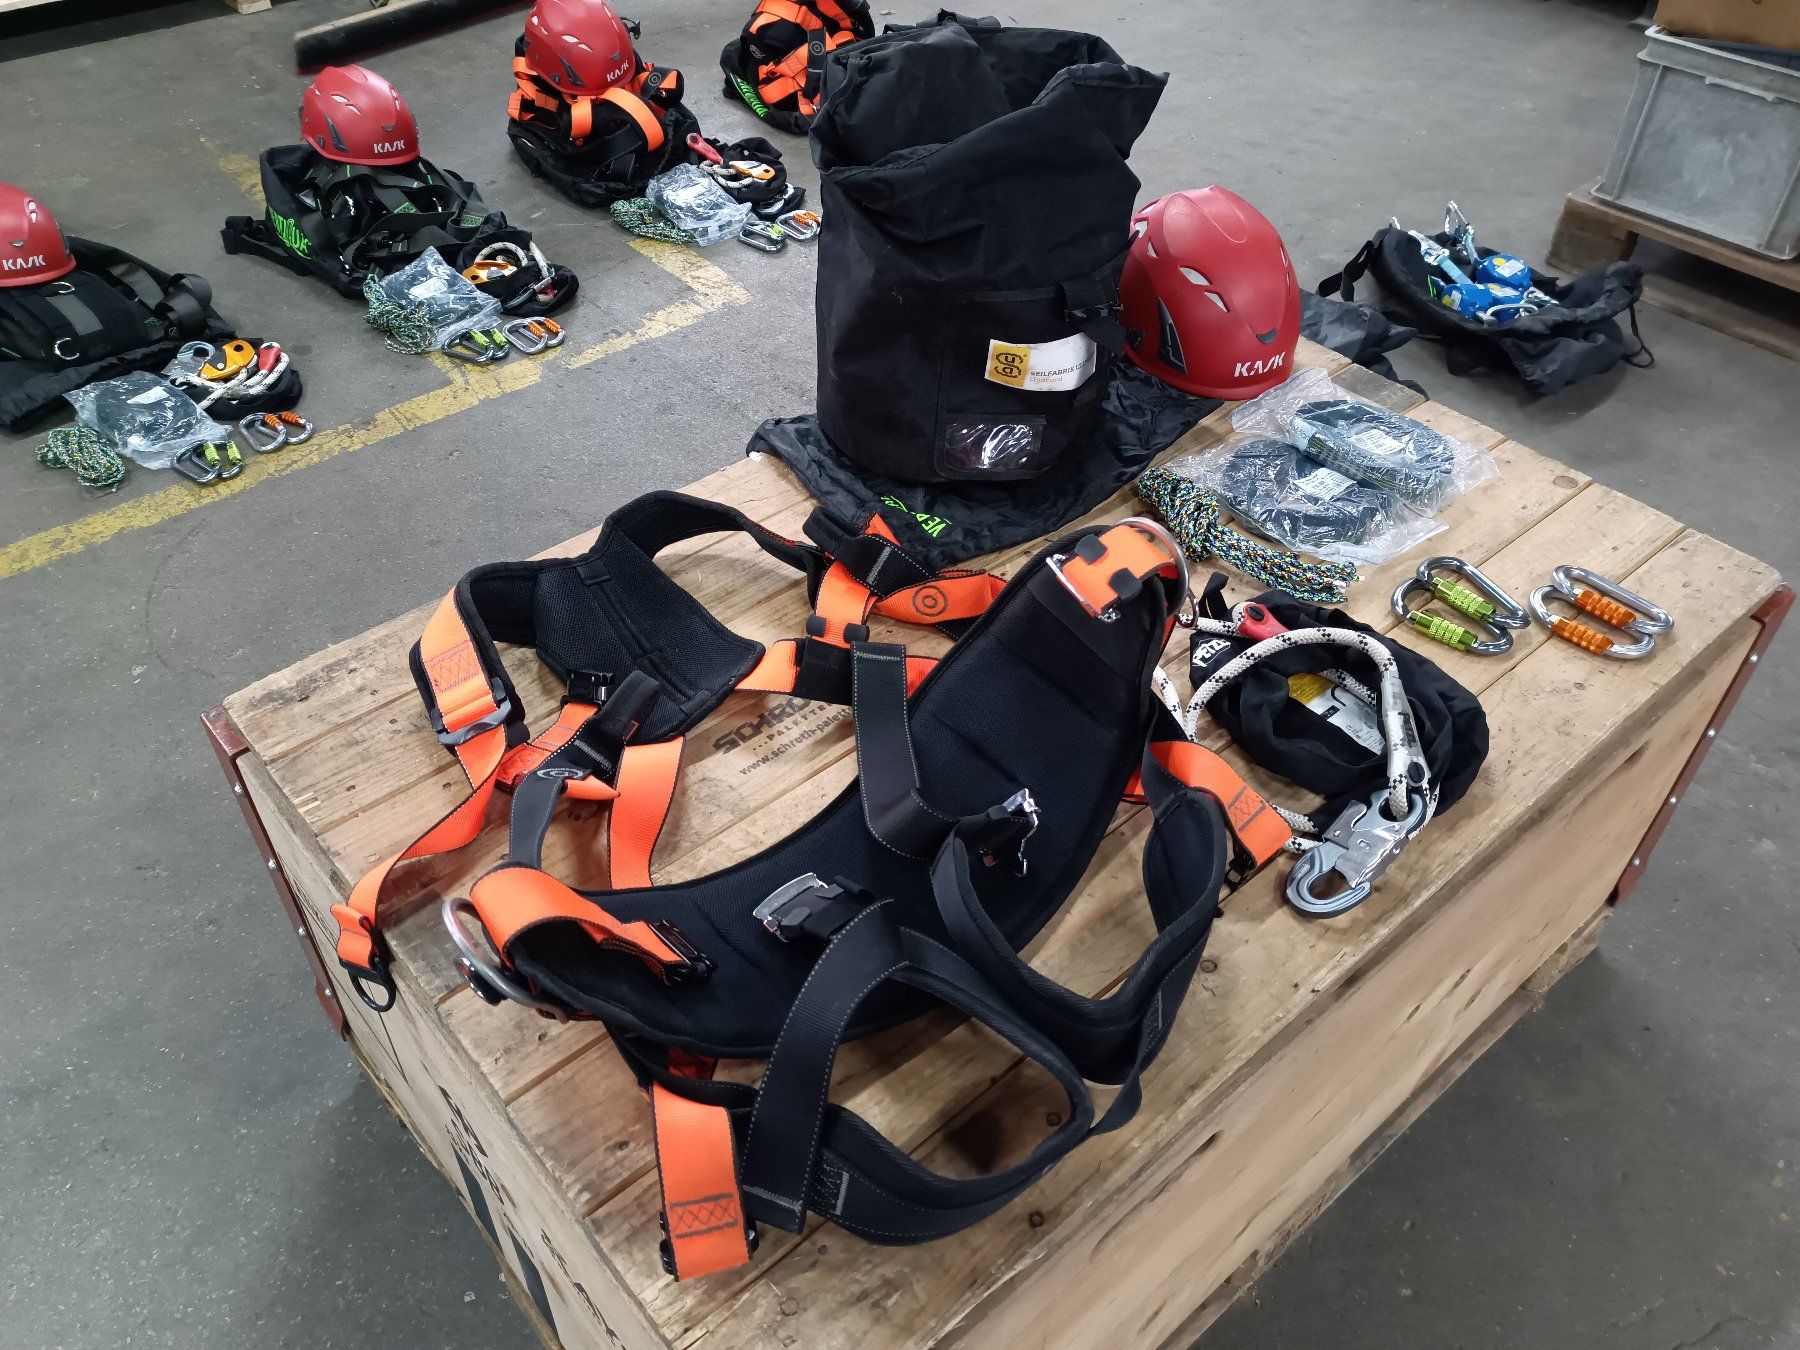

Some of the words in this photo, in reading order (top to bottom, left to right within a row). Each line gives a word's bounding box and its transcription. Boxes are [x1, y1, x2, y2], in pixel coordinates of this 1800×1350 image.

[373, 140, 405, 154] KASK
[2, 255, 46, 270] KASK
[1234, 351, 1286, 377] KASK
[1030, 365, 1076, 378] SEILFABRIK
